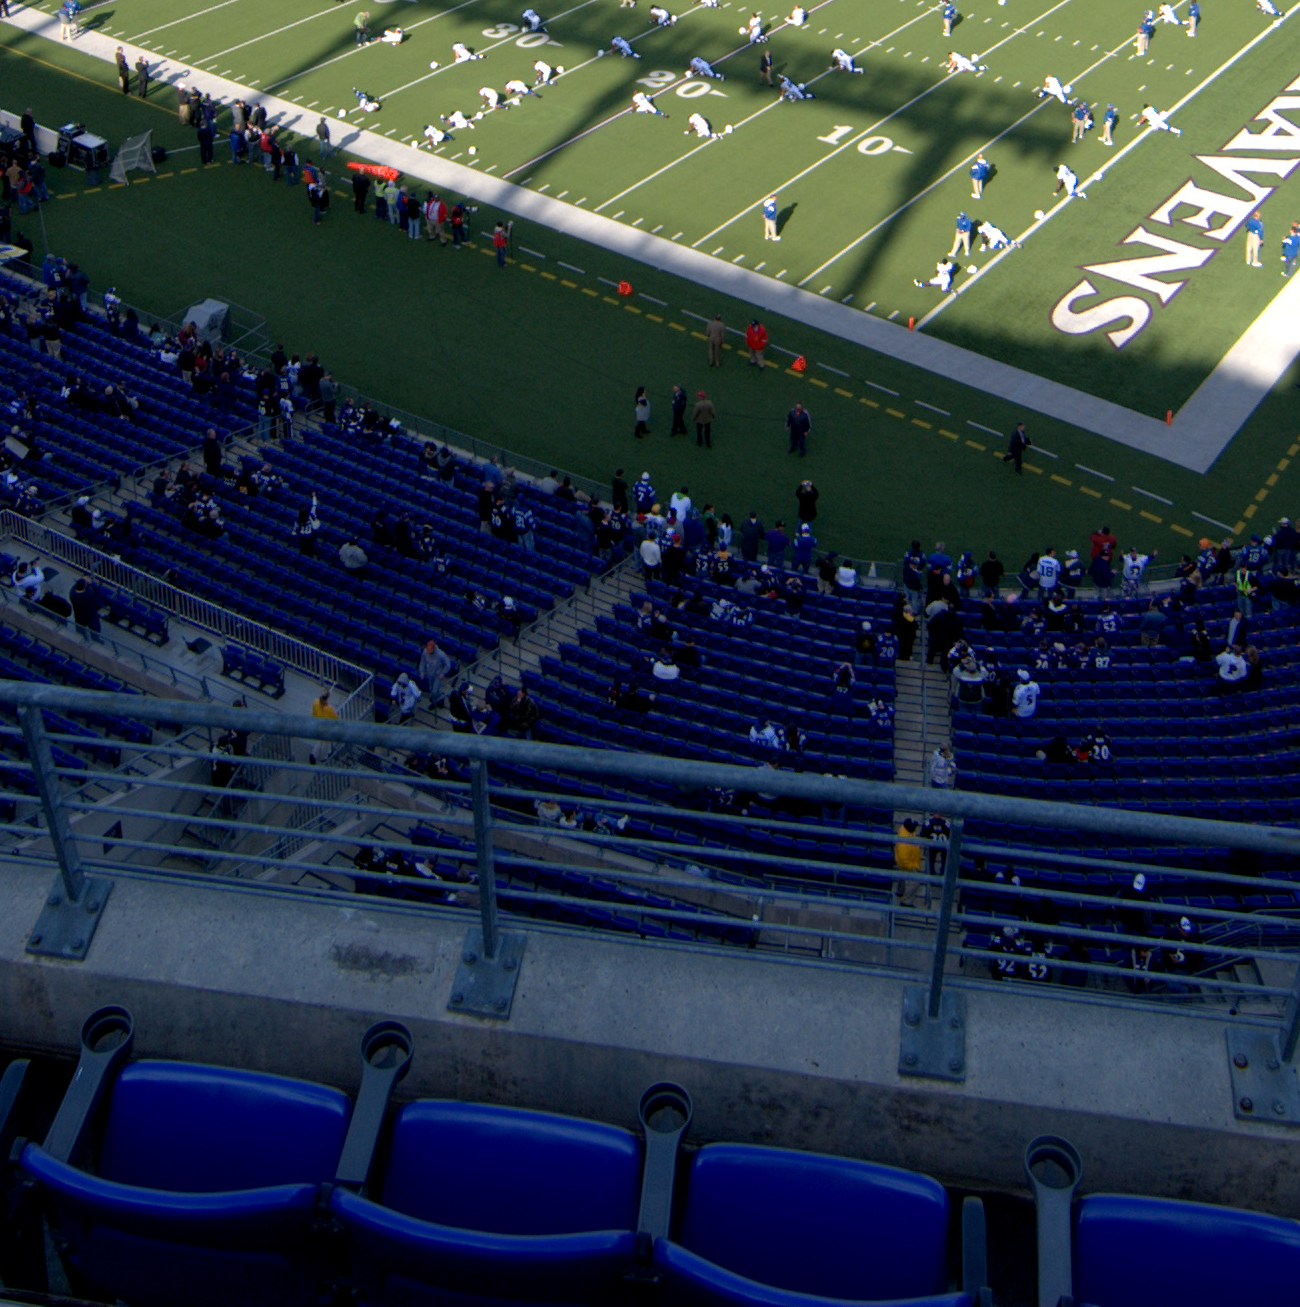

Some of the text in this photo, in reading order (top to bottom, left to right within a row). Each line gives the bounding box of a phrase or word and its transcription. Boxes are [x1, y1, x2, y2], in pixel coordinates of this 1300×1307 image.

[482, 22, 551, 49] 30
[636, 69, 713, 99] 20
[817, 124, 893, 156] 10
[1041, 565, 1054, 577] 18
[880, 647, 895, 659] 20
[1095, 656, 1111, 668] 87
[1025, 694, 1032, 705] 5
[1092, 744, 1109, 760] 20
